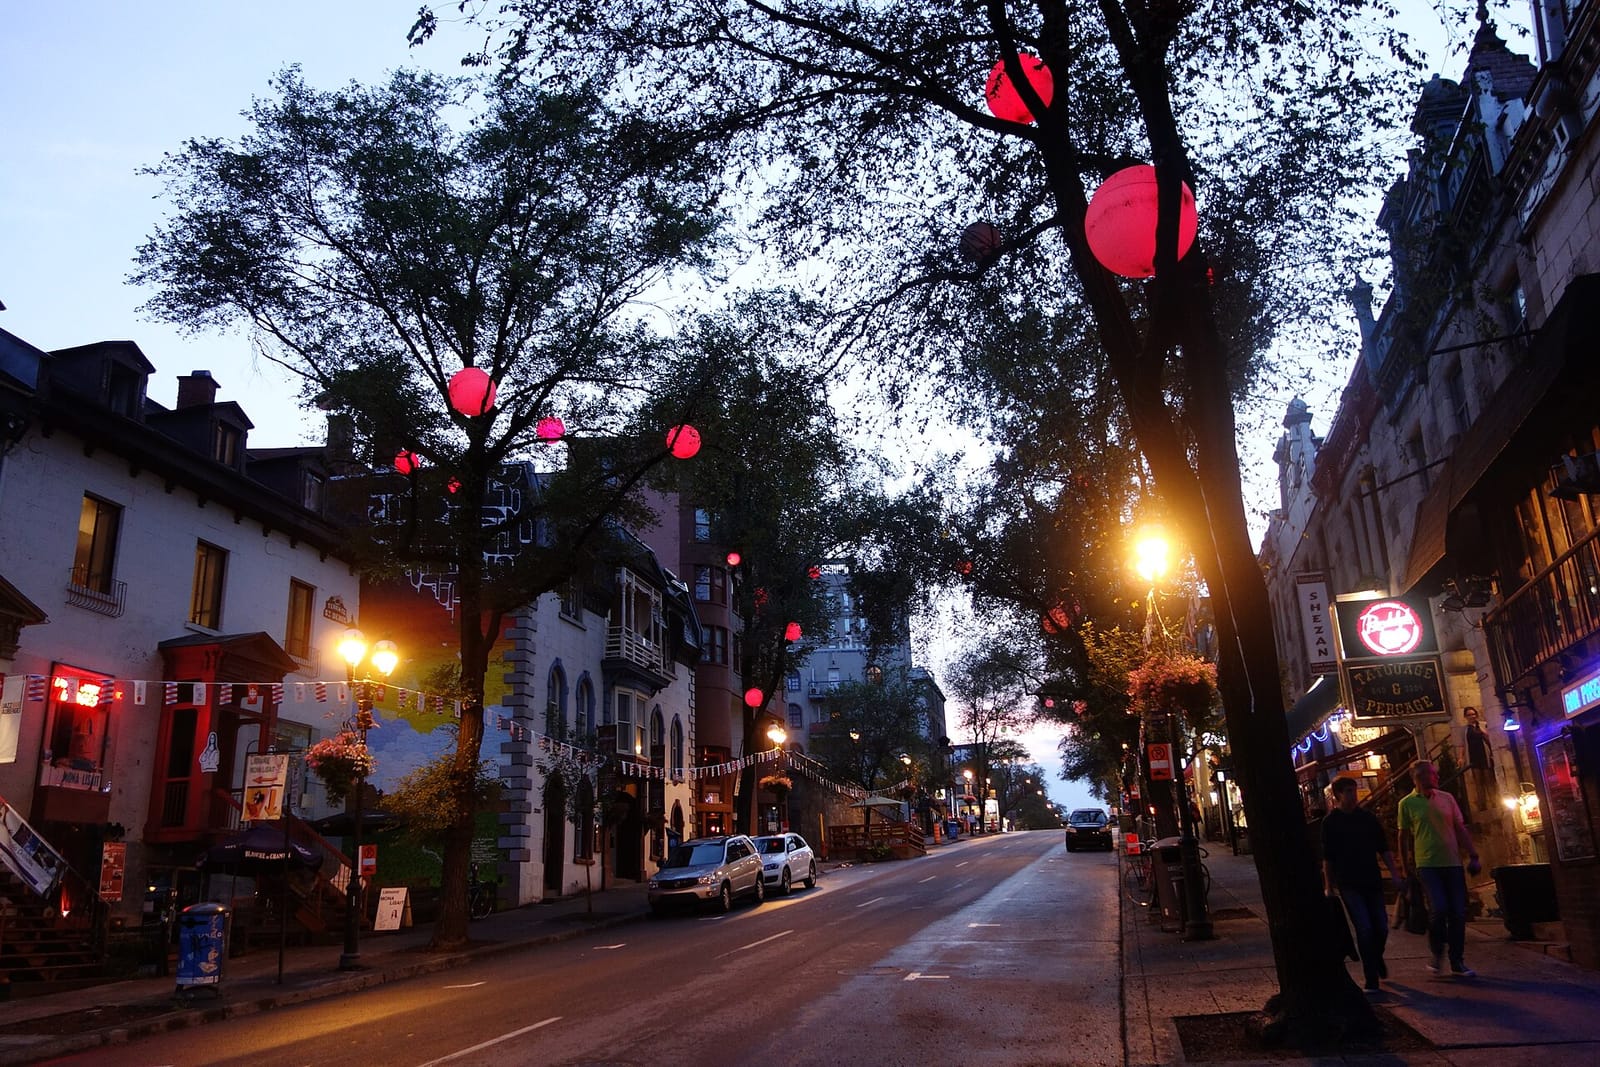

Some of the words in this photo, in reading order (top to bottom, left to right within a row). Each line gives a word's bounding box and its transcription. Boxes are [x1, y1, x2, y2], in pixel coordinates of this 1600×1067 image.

[1309, 592, 1329, 657] SHEZAN
[1353, 663, 1433, 686] TATOUAGE
[1391, 682, 1401, 696] &
